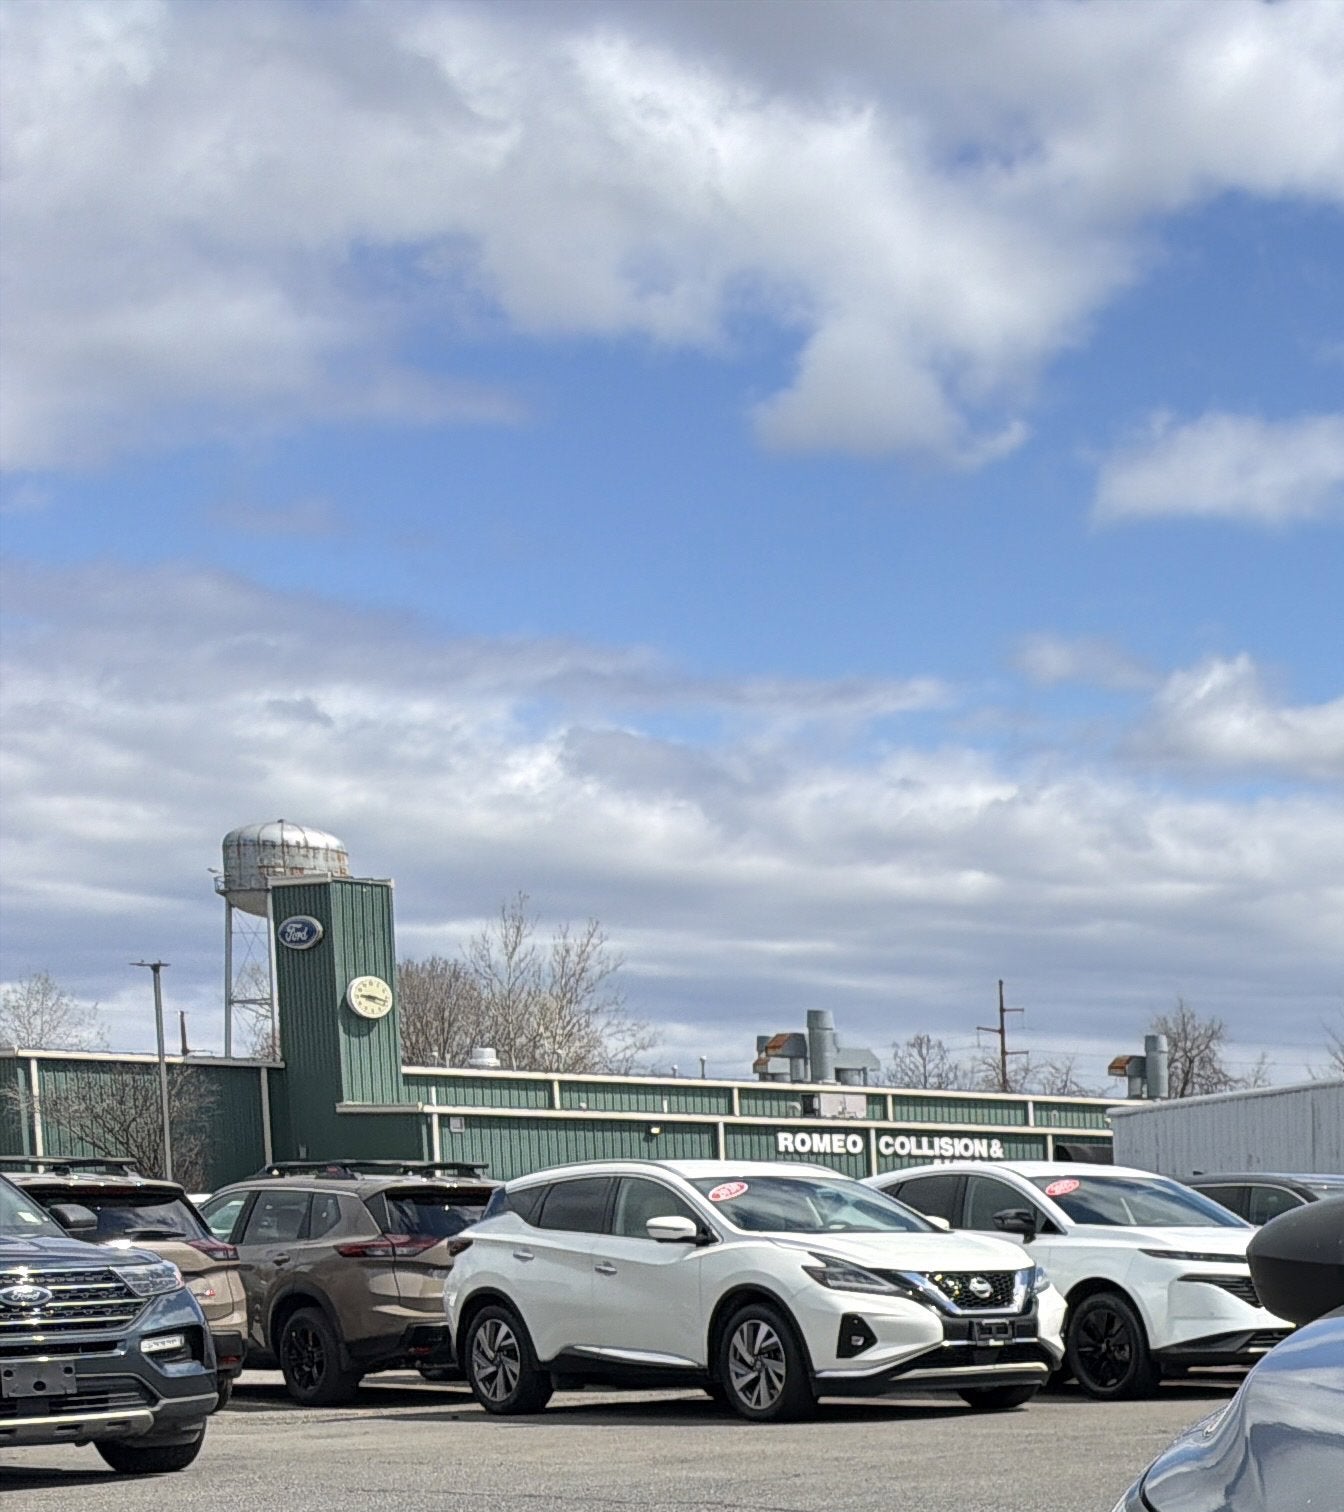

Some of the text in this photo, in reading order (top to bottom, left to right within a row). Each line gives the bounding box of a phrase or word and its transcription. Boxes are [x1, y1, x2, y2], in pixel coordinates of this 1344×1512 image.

[285, 923, 308, 941] Ford
[777, 1132, 863, 1153] ROMEO
[879, 1135, 986, 1157] COLLISION
